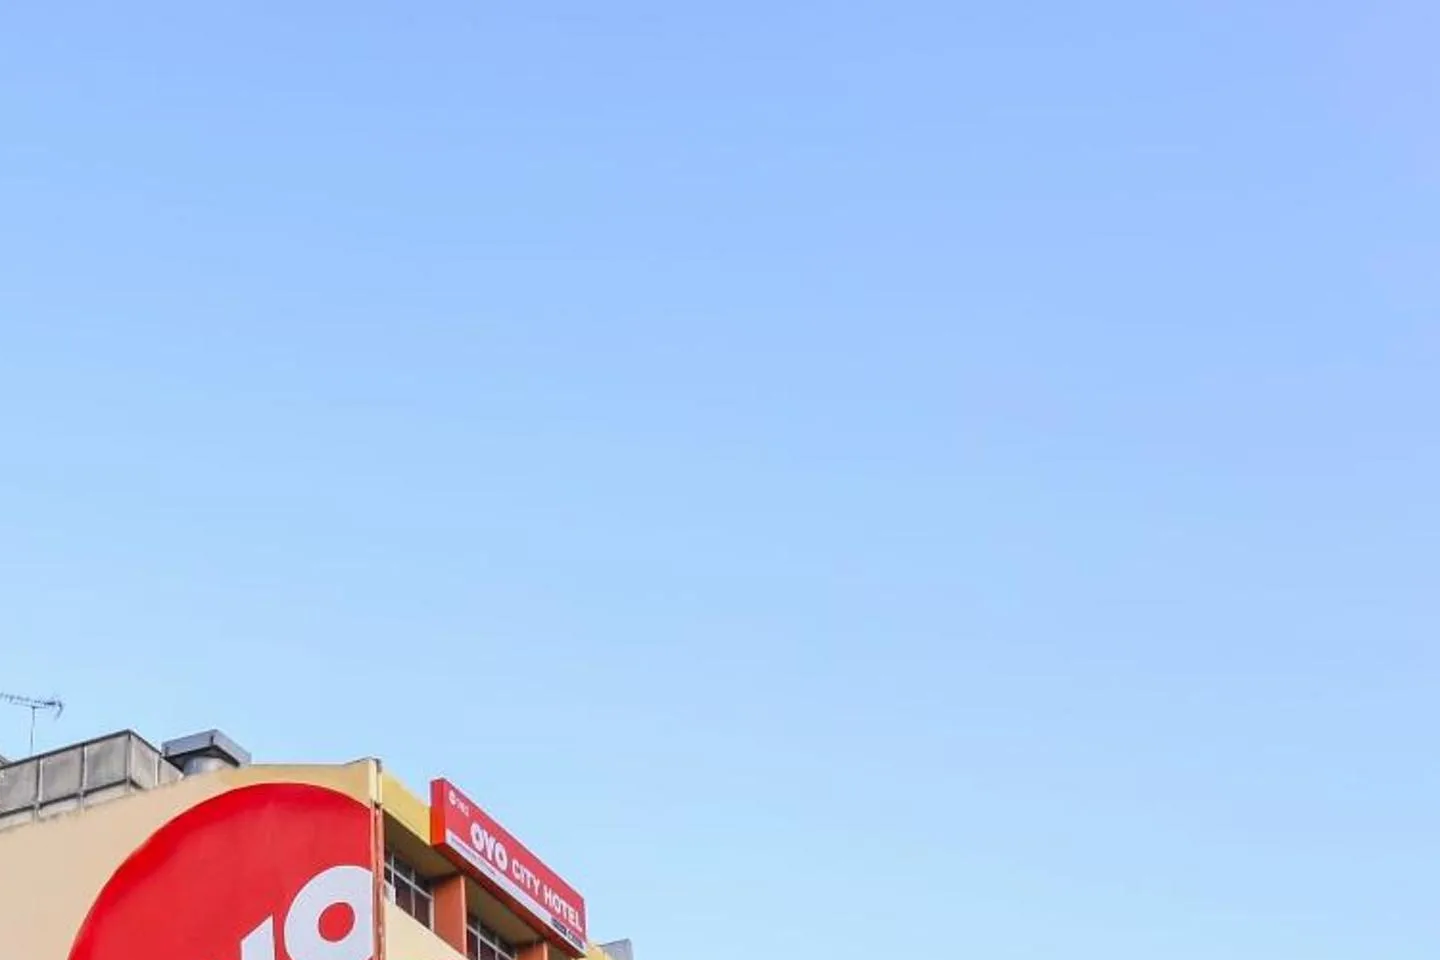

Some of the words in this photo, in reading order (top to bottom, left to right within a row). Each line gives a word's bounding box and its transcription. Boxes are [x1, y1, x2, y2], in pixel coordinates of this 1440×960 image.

[470, 822, 508, 872] OYO
[512, 859, 540, 896] CITY
[543, 885, 583, 932] HOTEL
